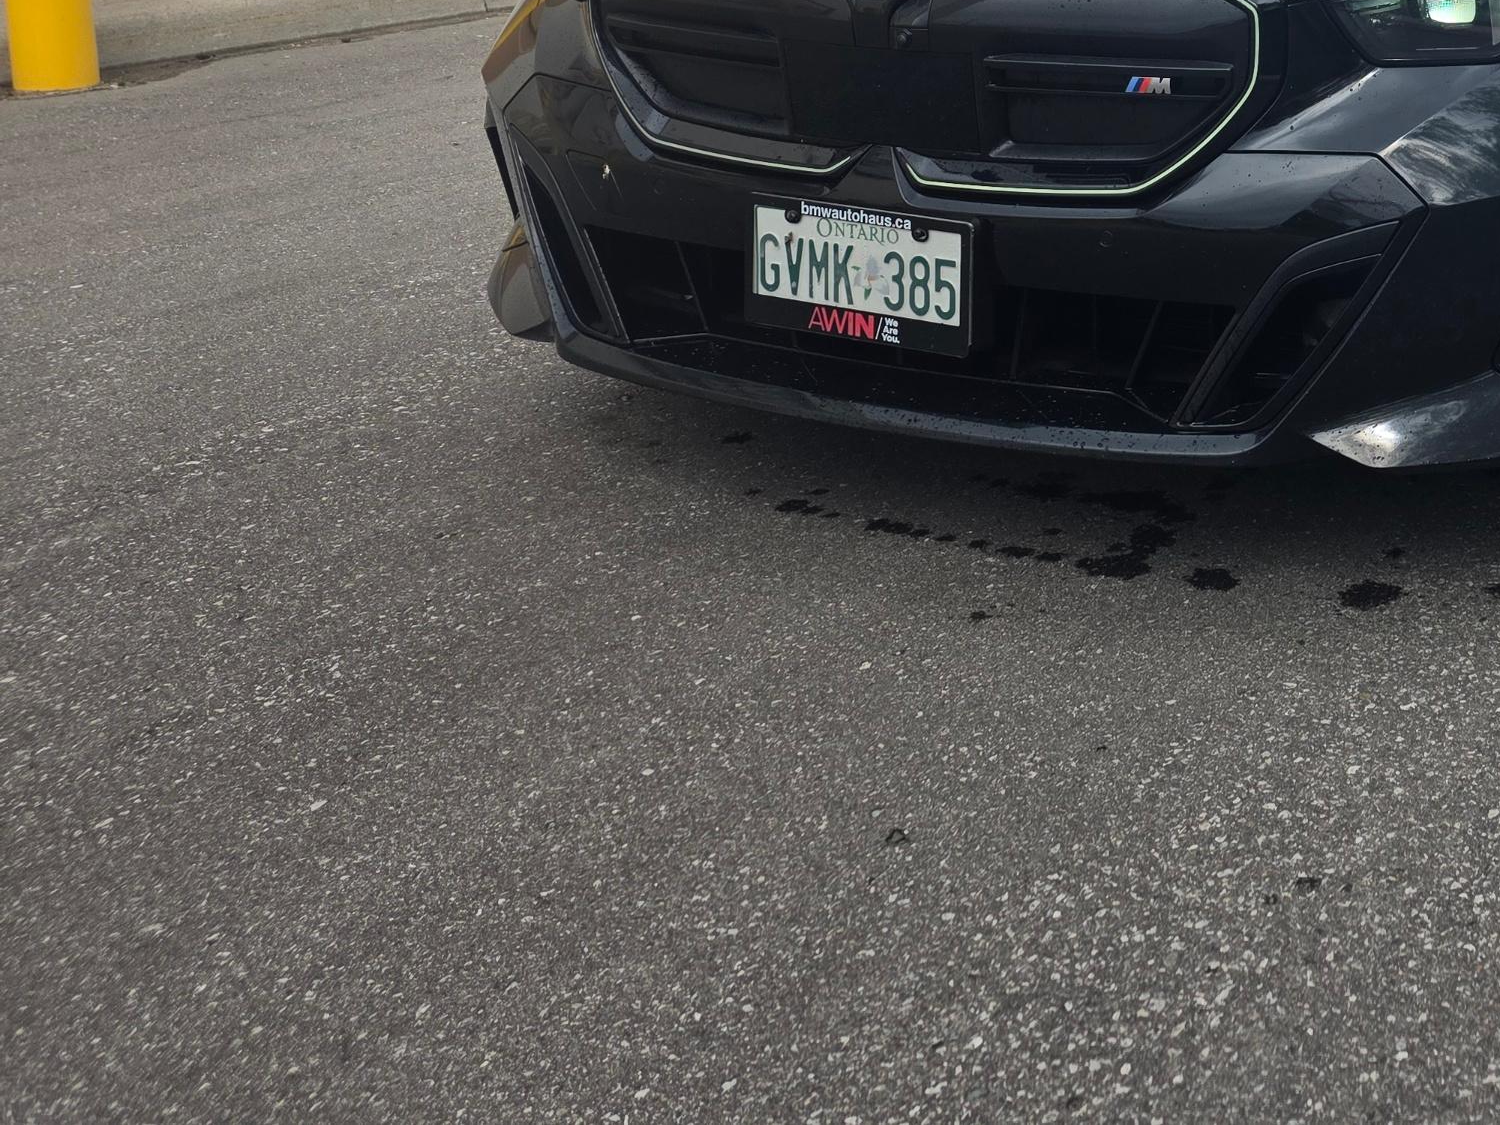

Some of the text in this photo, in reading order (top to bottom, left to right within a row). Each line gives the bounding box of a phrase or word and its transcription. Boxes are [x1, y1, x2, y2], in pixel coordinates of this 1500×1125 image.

[801, 201, 912, 230] bmwautohaus.ca
[816, 218, 899, 245] ONTARIO
[760, 233, 957, 321] GVMK 385
[808, 306, 876, 340] AWIN
[882, 325, 899, 335] Are
[884, 317, 899, 327] We
[881, 333, 900, 344] You.
